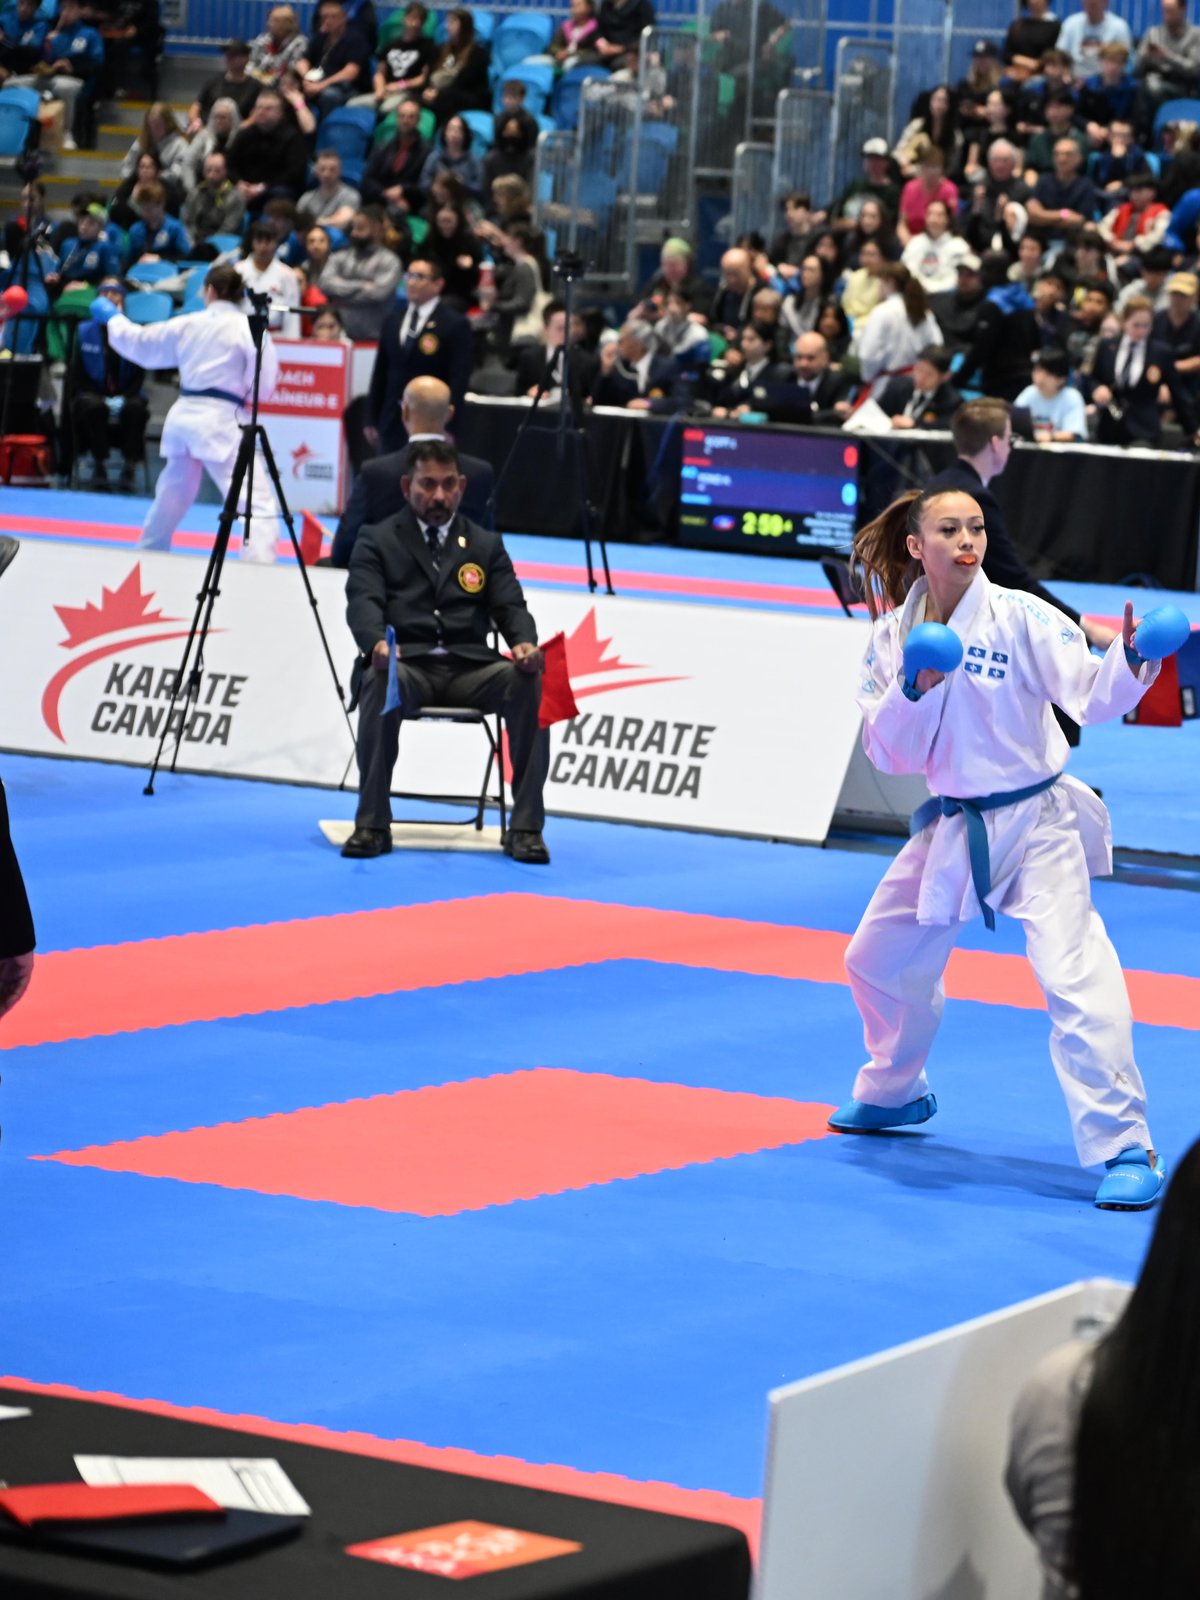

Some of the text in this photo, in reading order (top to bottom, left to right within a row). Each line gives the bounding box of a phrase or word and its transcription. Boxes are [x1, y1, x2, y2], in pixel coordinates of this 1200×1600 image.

[104, 662, 249, 708] KARATE
[90, 701, 233, 747] CANADA
[562, 713, 717, 759] KARATE
[550, 751, 704, 800] CANADA
